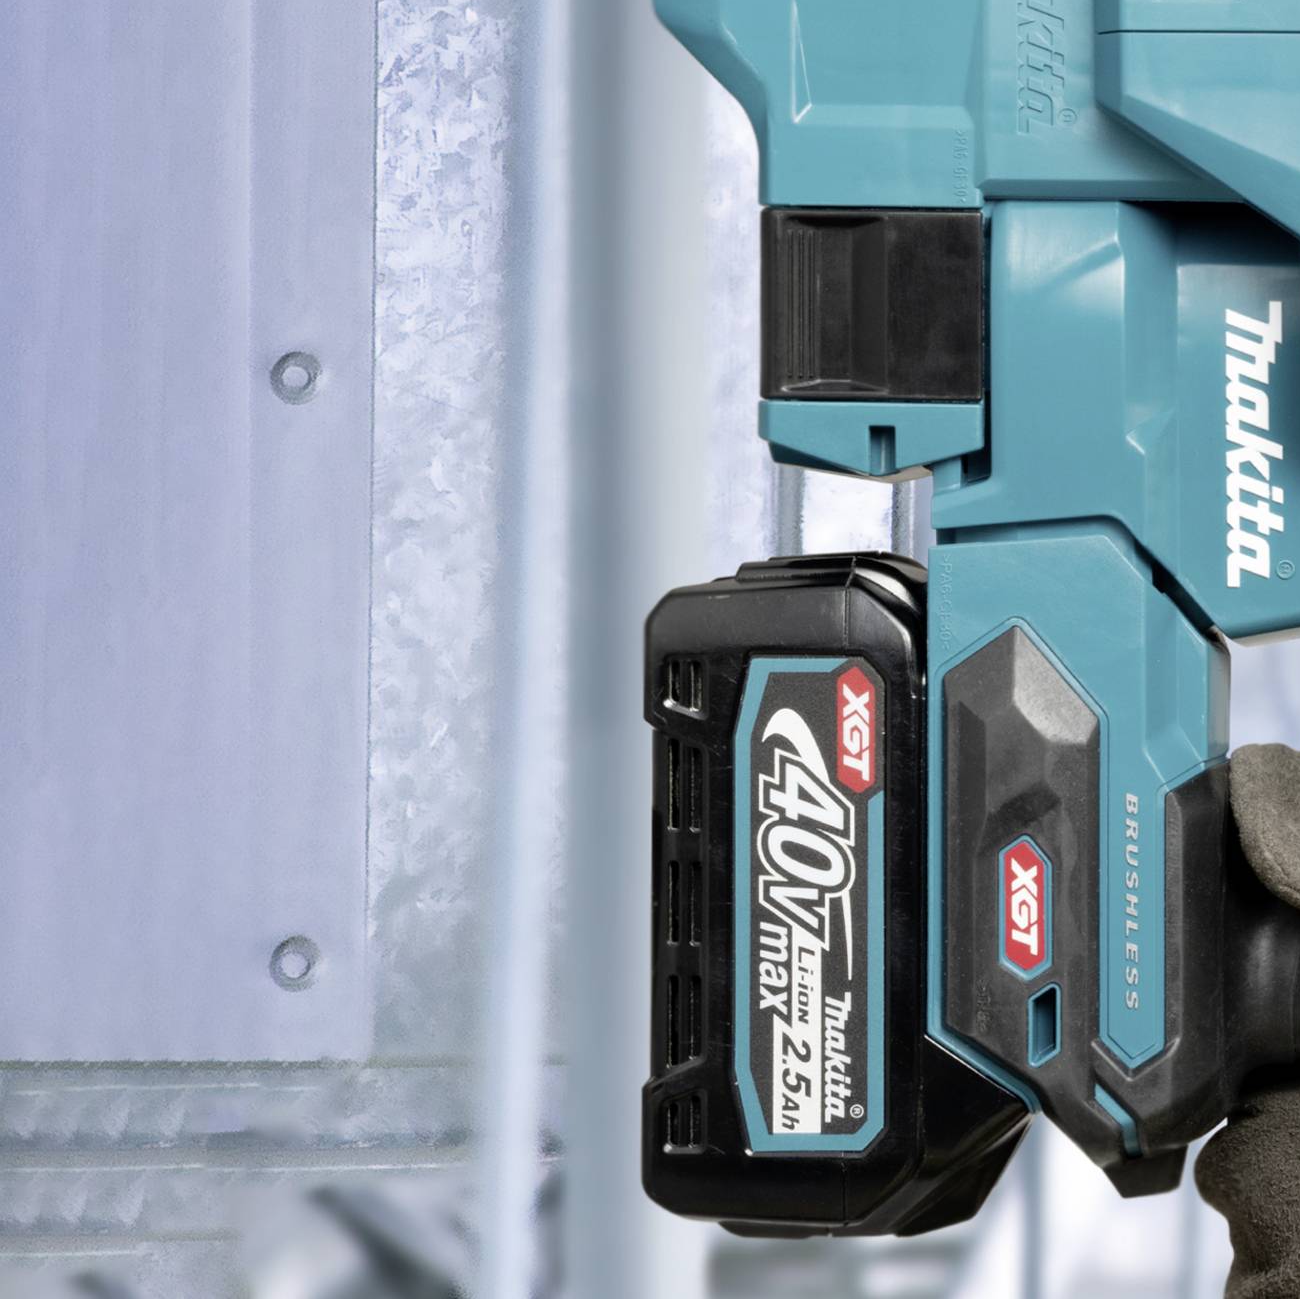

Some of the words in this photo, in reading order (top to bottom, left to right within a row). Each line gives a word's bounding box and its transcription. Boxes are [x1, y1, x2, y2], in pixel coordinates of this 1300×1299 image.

[842, 683, 870, 781] XGT
[1011, 858, 1038, 956] XGT
[1125, 793, 1140, 1010] BRUSHLESS
